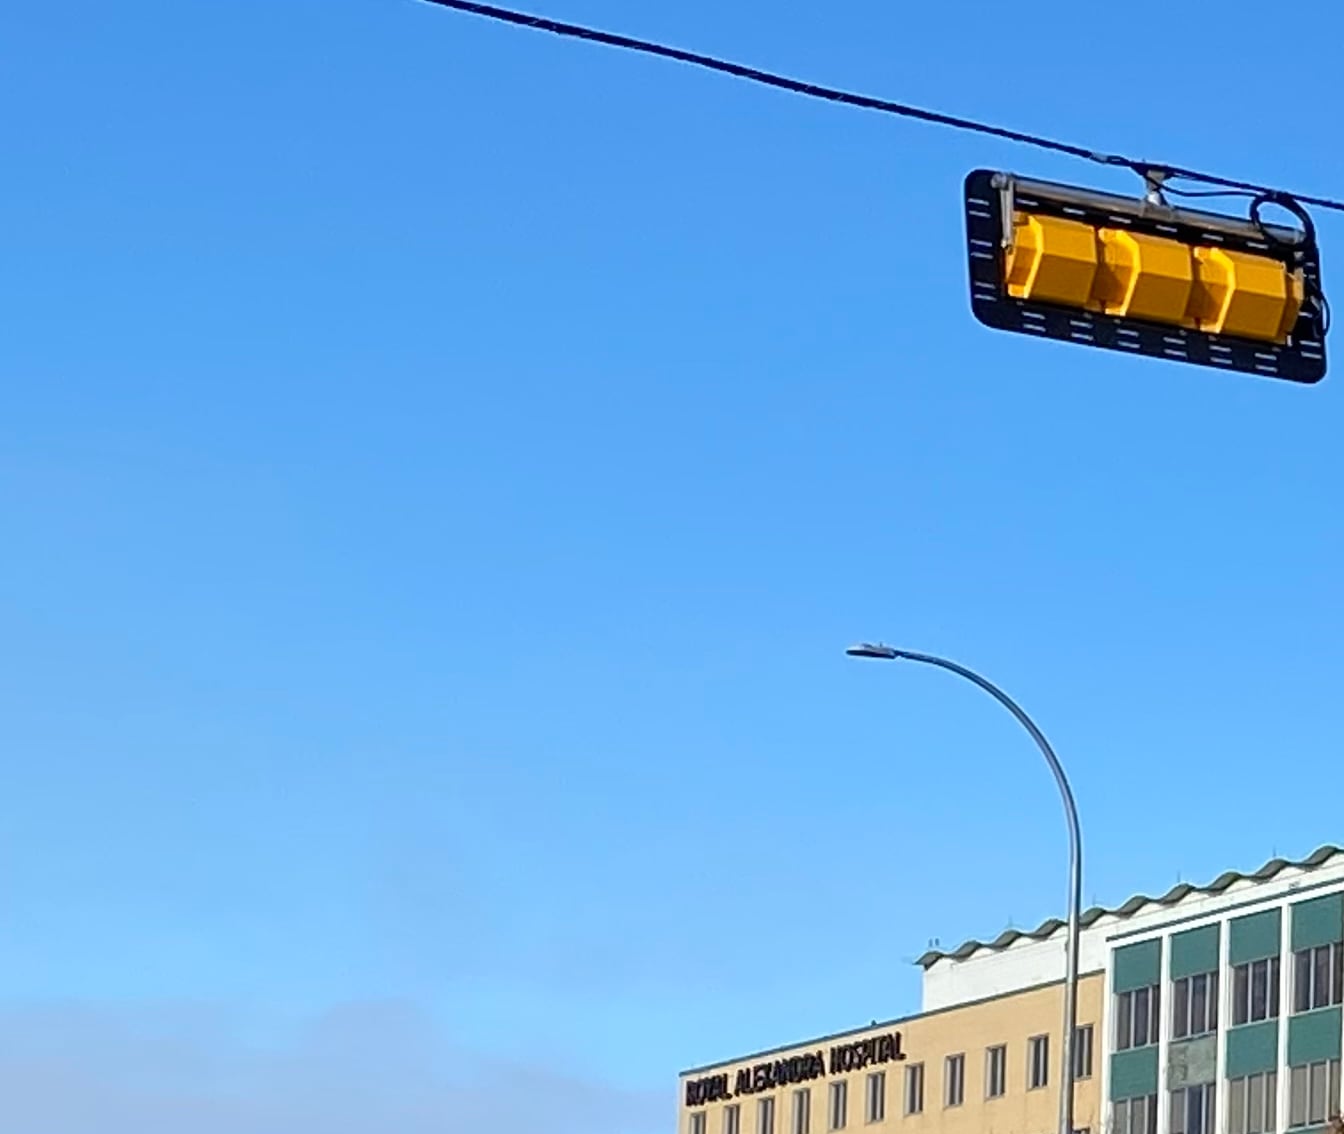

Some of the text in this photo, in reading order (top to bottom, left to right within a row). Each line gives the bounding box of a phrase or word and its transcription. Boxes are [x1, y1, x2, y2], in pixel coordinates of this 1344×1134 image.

[686, 1031, 906, 1106] ROYAL ALEXANDRA HOSPITAL
